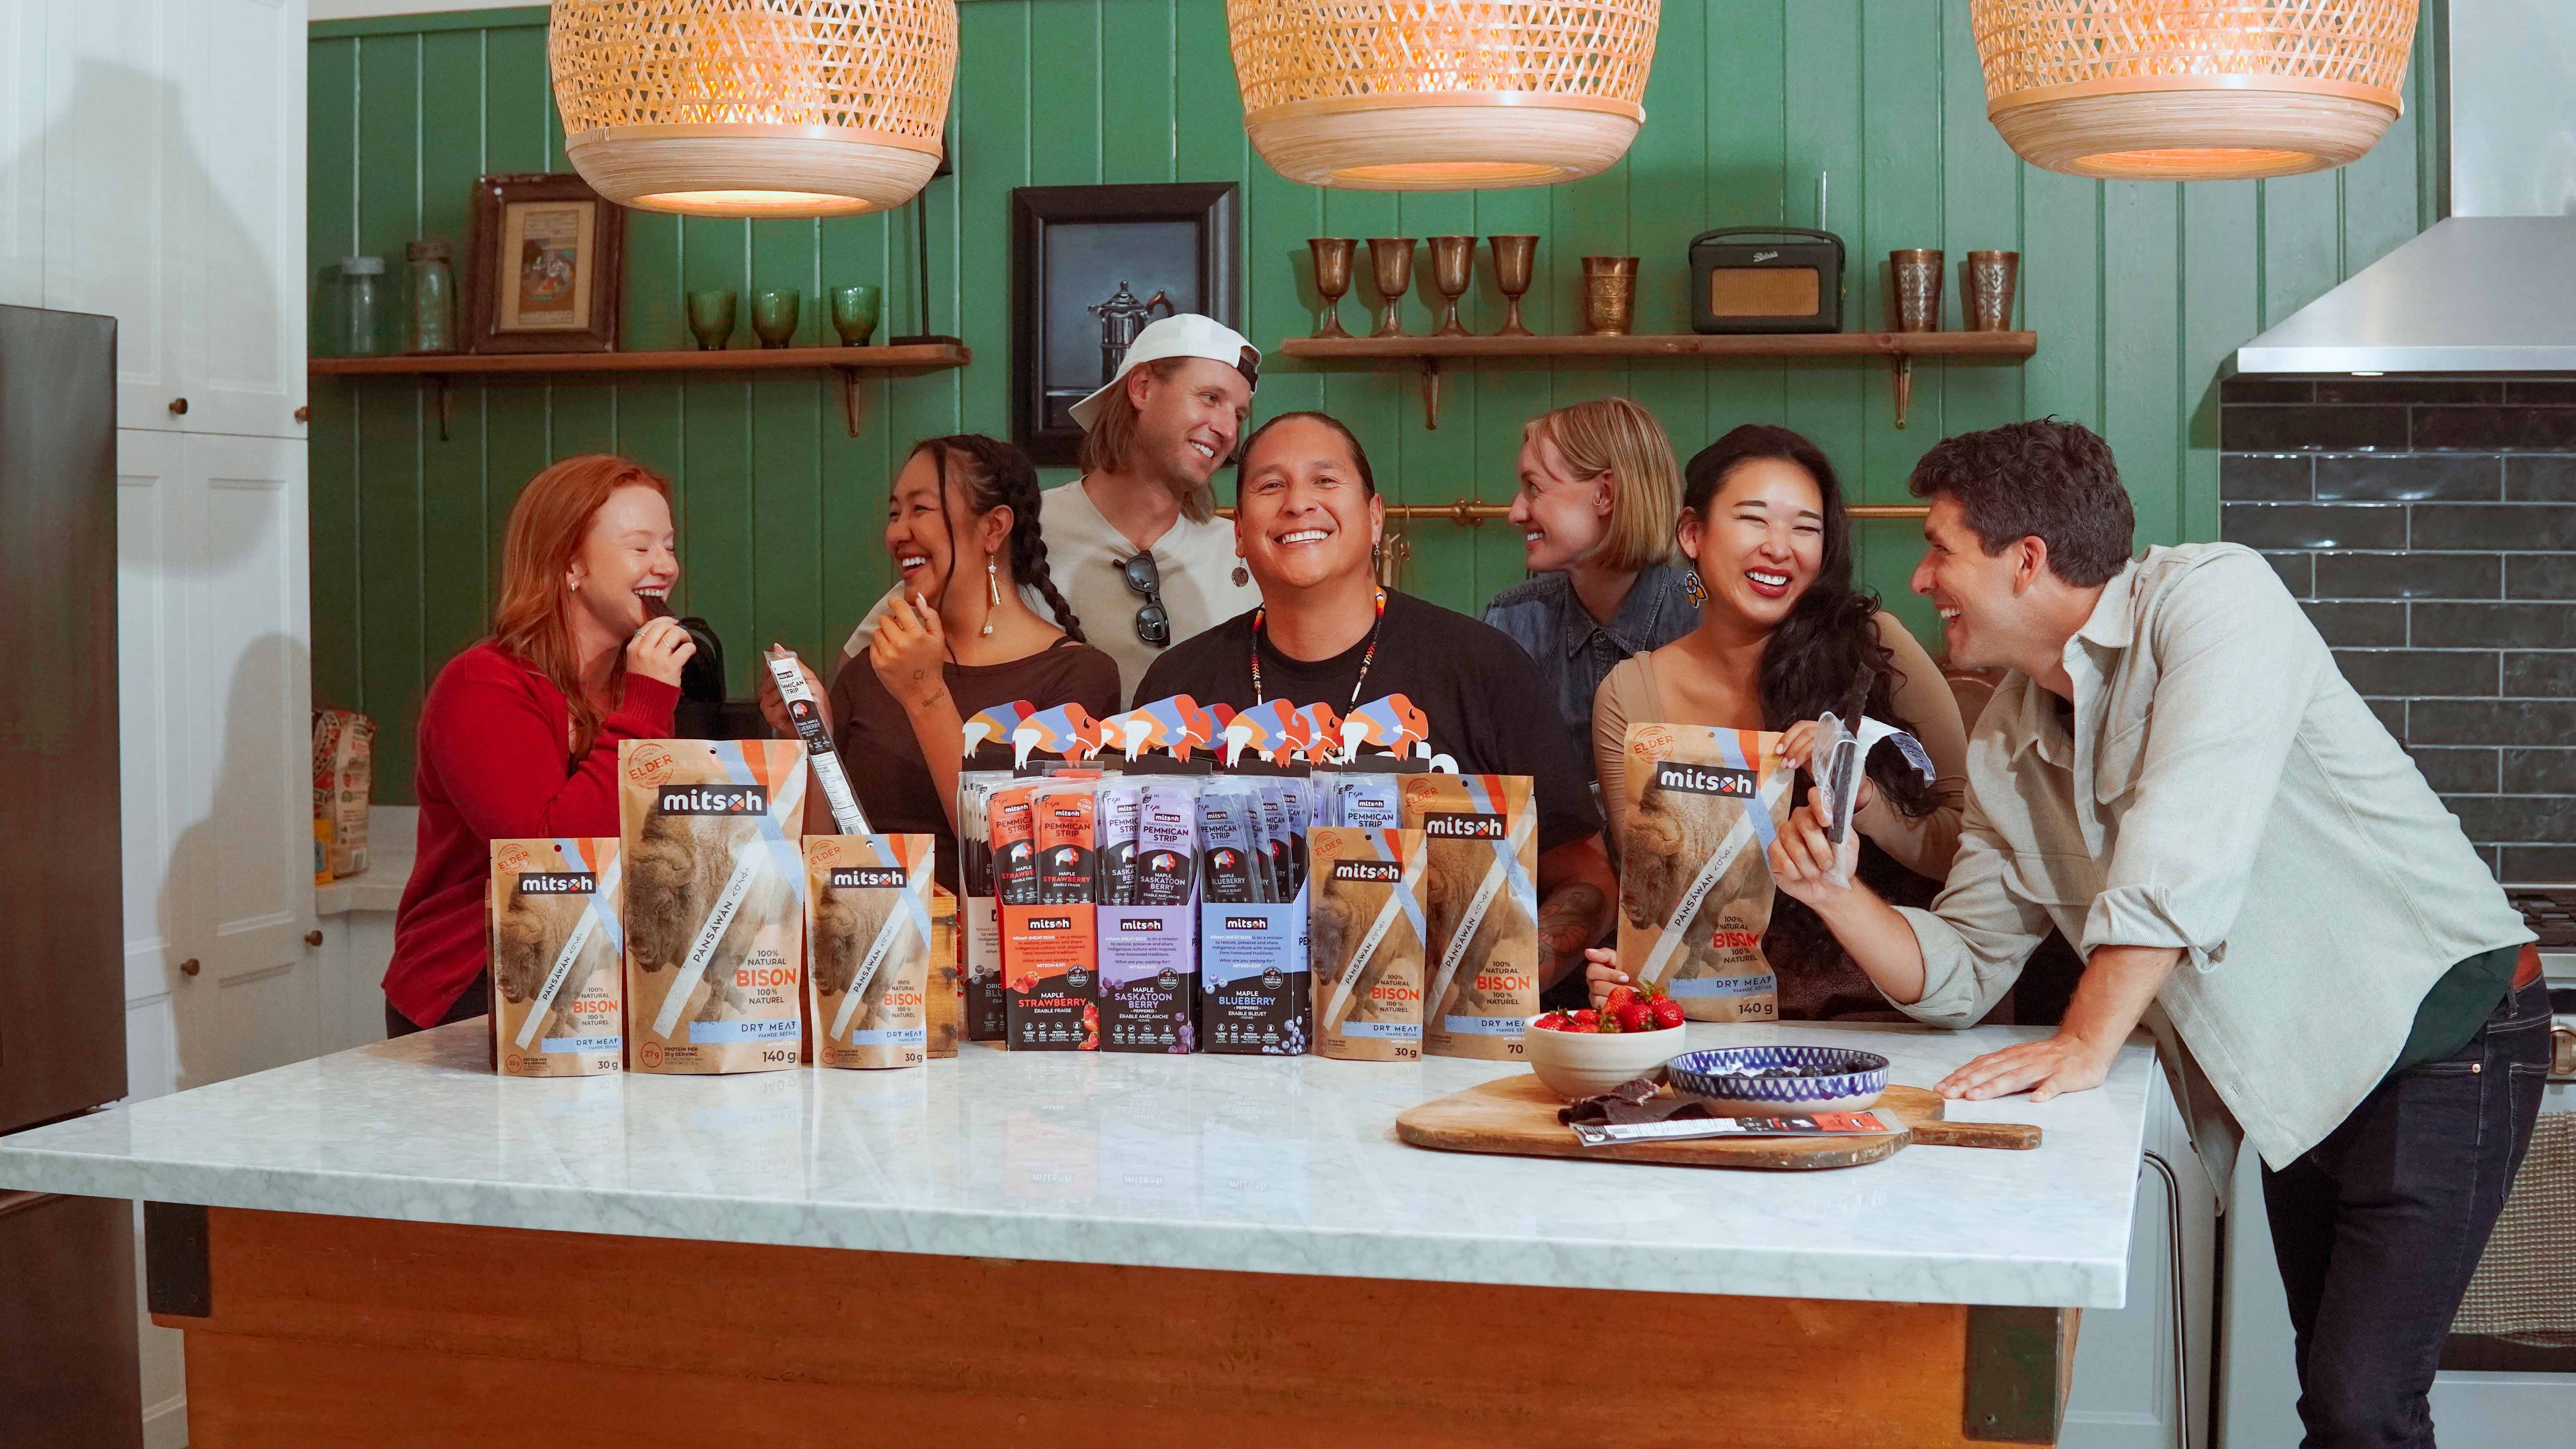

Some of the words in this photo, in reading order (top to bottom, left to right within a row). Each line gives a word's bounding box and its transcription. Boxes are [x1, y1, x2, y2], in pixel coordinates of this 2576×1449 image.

[1634, 735, 1674, 754] ELDER
[629, 754, 673, 780] ELDER
[1661, 769, 1751, 794] mitsoh
[664, 789, 762, 811] mitsoh
[1406, 787, 1438, 807] ELDER
[1144, 826, 1188, 835] PEMMICAN
[1427, 816, 1502, 836] mitsoh
[1315, 838, 1343, 856] ELDER
[498, 851, 530, 870] ELDER
[810, 847, 841, 865] ELDER
[835, 871, 903, 885] mitsoh
[1336, 863, 1399, 879] mitsoh
[522, 875, 593, 891] mitsoh
[1141, 876, 1185, 885] SASKATOON
[1713, 933, 1758, 948] BISON
[1724, 955, 1758, 963] NATUREL
[736, 968, 797, 987] BISON
[1477, 976, 1531, 991] BISON
[1717, 980, 1738, 988] DRY
[1745, 976, 1771, 986] MEAT
[884, 993, 922, 1005] BISON
[1219, 997, 1276, 1005] BLUEBERRY
[1372, 987, 1419, 1001] BISON
[573, 1000, 618, 1014] BISON
[1018, 998, 1087, 1007] STRAWBERRY
[1739, 1003, 1762, 1014] 140
[1764, 1004, 1773, 1014] g
[741, 1023, 763, 1032] DRY
[770, 1022, 796, 1031] MEAT
[1395, 1048, 1408, 1056] 30
[1411, 1049, 1417, 1058] g
[1508, 1044, 1523, 1054] 70
[763, 1051, 784, 1062] 140
[788, 1053, 796, 1063] g
[917, 1054, 922, 1062] g
[598, 1061, 610, 1069] 30
[612, 1061, 618, 1069] g
